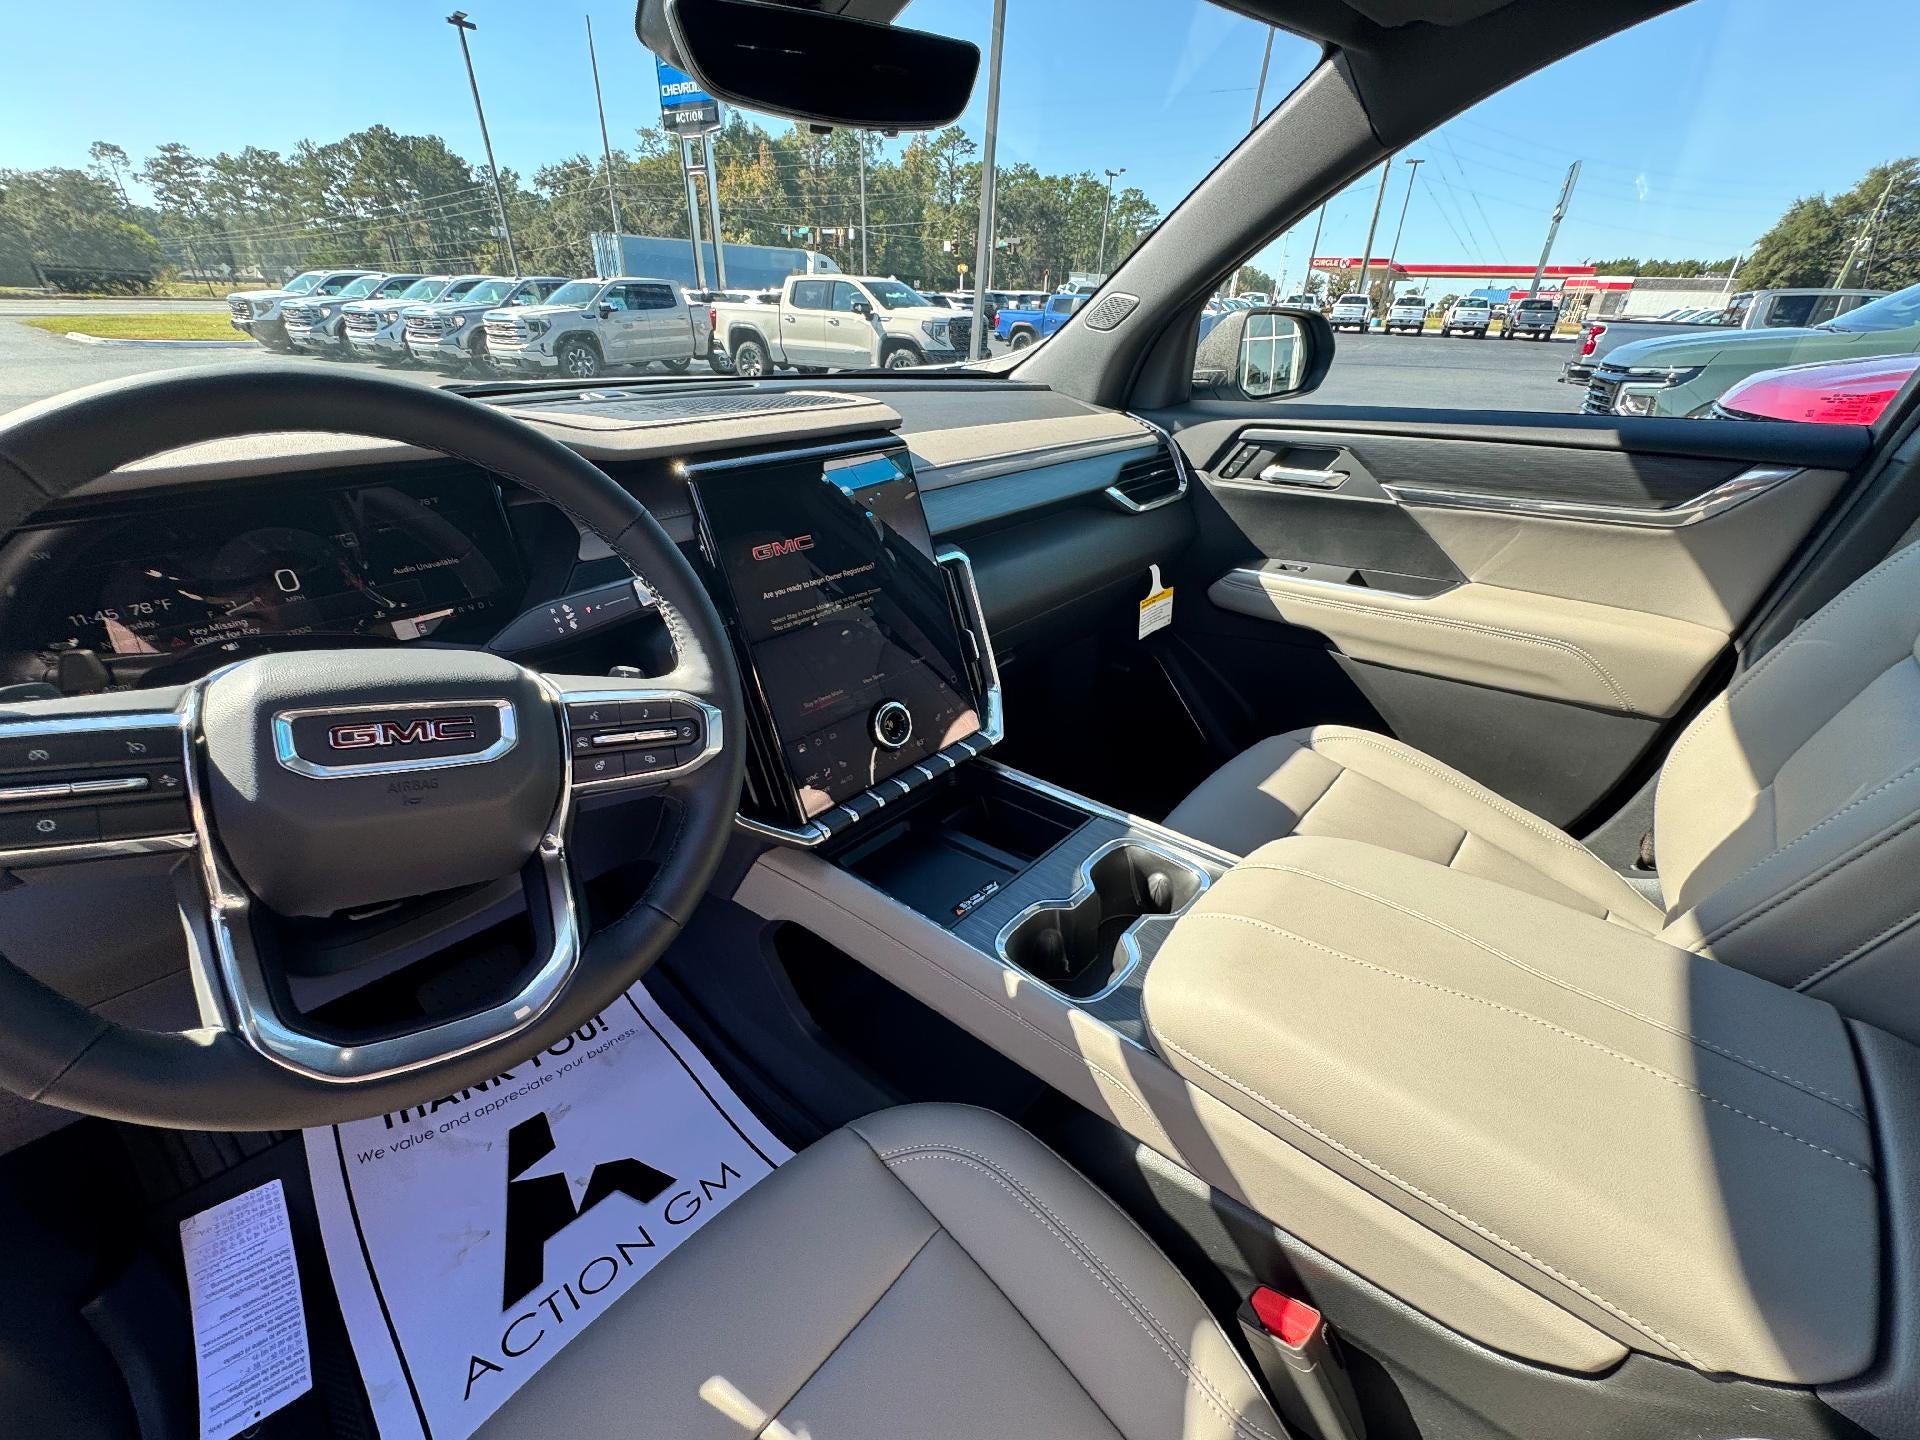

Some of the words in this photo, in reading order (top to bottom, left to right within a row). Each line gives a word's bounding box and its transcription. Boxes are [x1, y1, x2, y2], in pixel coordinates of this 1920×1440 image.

[661, 81, 702, 97] CHEVROL
[675, 110, 704, 123] ACTION
[1313, 259, 1339, 267] CIRCLE
[752, 534, 815, 561] GMC
[392, 565, 415, 575] Audio
[415, 558, 460, 571] Unavailable
[273, 567, 301, 593] 0
[763, 592, 774, 600] Are
[774, 589, 786, 598] you
[786, 583, 803, 594] ready
[809, 577, 826, 588] begin
[825, 573, 843, 582] Owner
[842, 562, 875, 577] Registration?
[68, 608, 120, 627] 11:45
[188, 625, 208, 637] Key
[209, 618, 249, 632] Missing
[193, 634, 220, 647] Check
[222, 630, 241, 641] for
[241, 626, 261, 638] Key
[328, 715, 475, 749] GMC
[387, 779, 439, 793] AIRBAG
[357, 1147, 385, 1165] We
[389, 1128, 435, 1153] value
[439, 1112, 472, 1134] and
[474, 1072, 554, 1119] appreciate
[556, 1056, 584, 1079] your
[586, 1027, 639, 1058] business.
[464, 1225, 656, 1401] ACTION
[663, 1161, 742, 1225] GM
